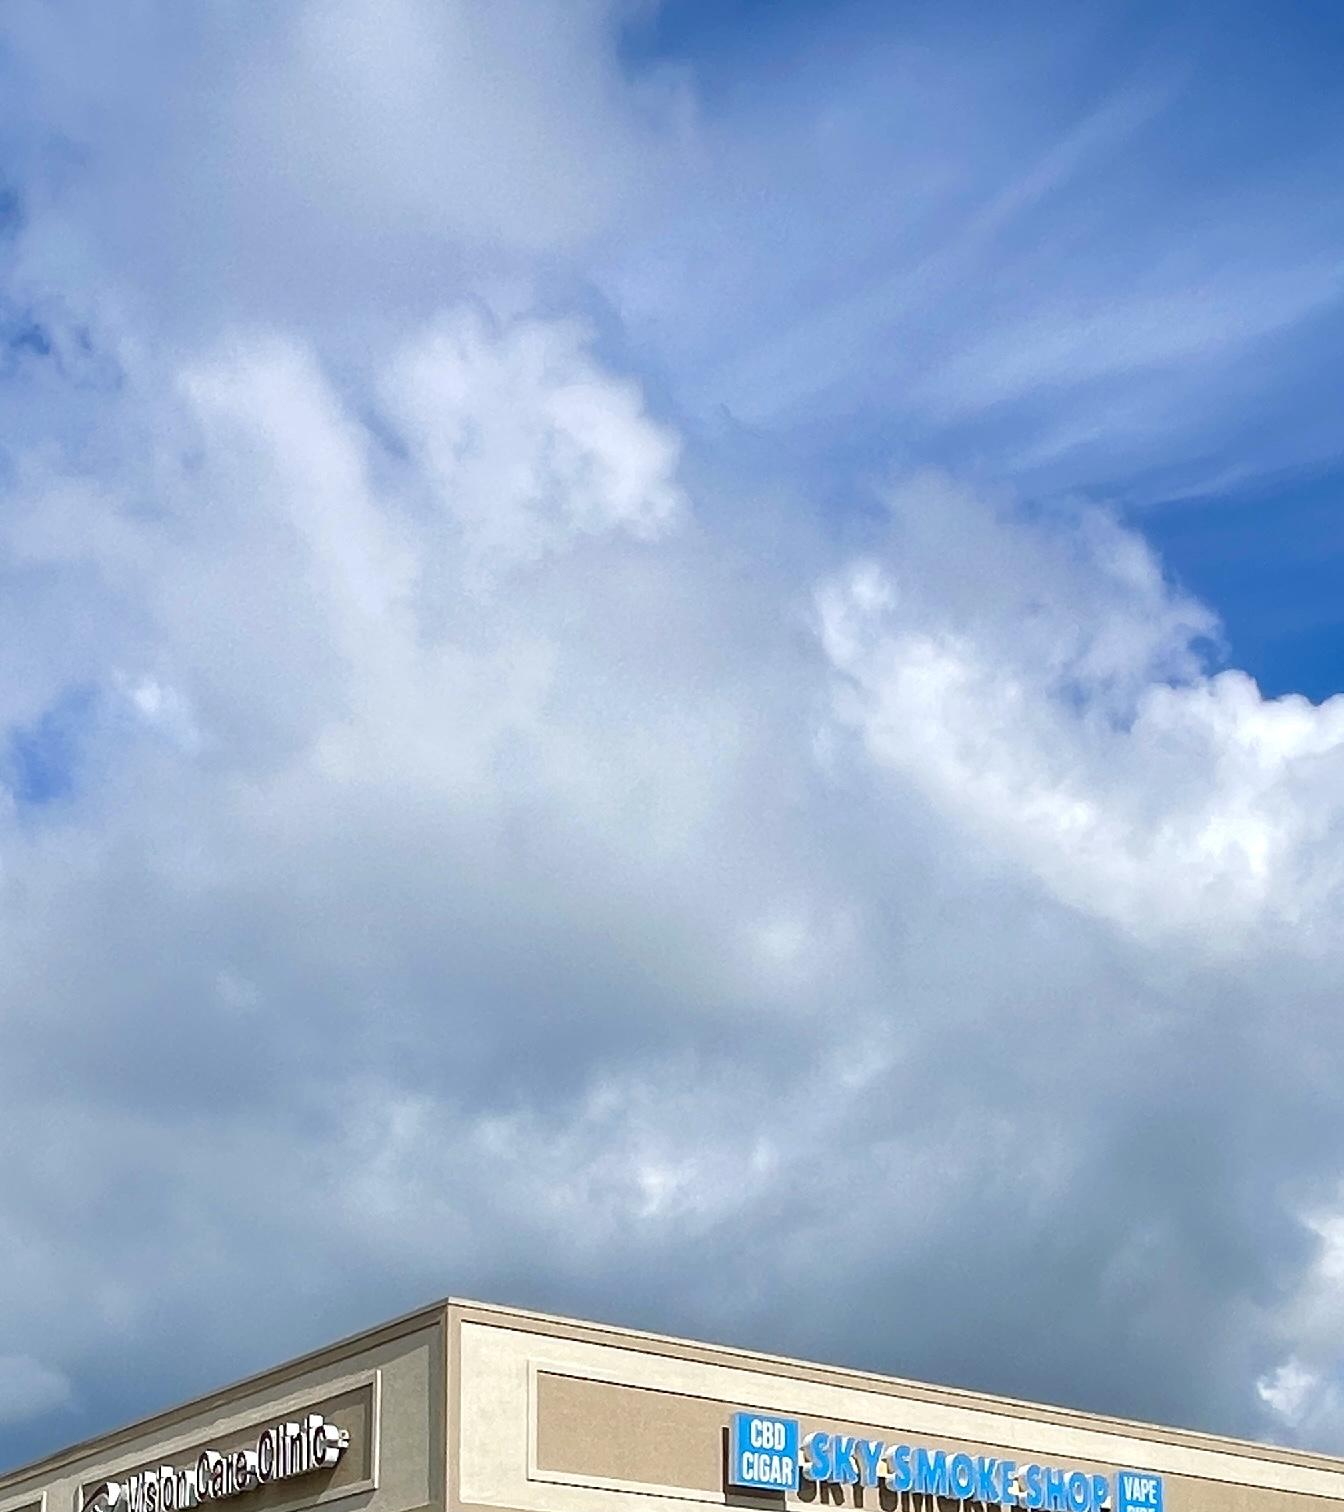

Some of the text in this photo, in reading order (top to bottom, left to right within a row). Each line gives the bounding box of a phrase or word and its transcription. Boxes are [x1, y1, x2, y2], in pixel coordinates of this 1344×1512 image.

[750, 1418, 786, 1451] CBD
[195, 1450, 257, 1502] Care
[257, 1414, 340, 1484] Clinic
[742, 1451, 793, 1486] CIGAR
[804, 1430, 884, 1489] SKY
[886, 1443, 1019, 1507] SMOKE
[1123, 1475, 1158, 1505] VAPE
